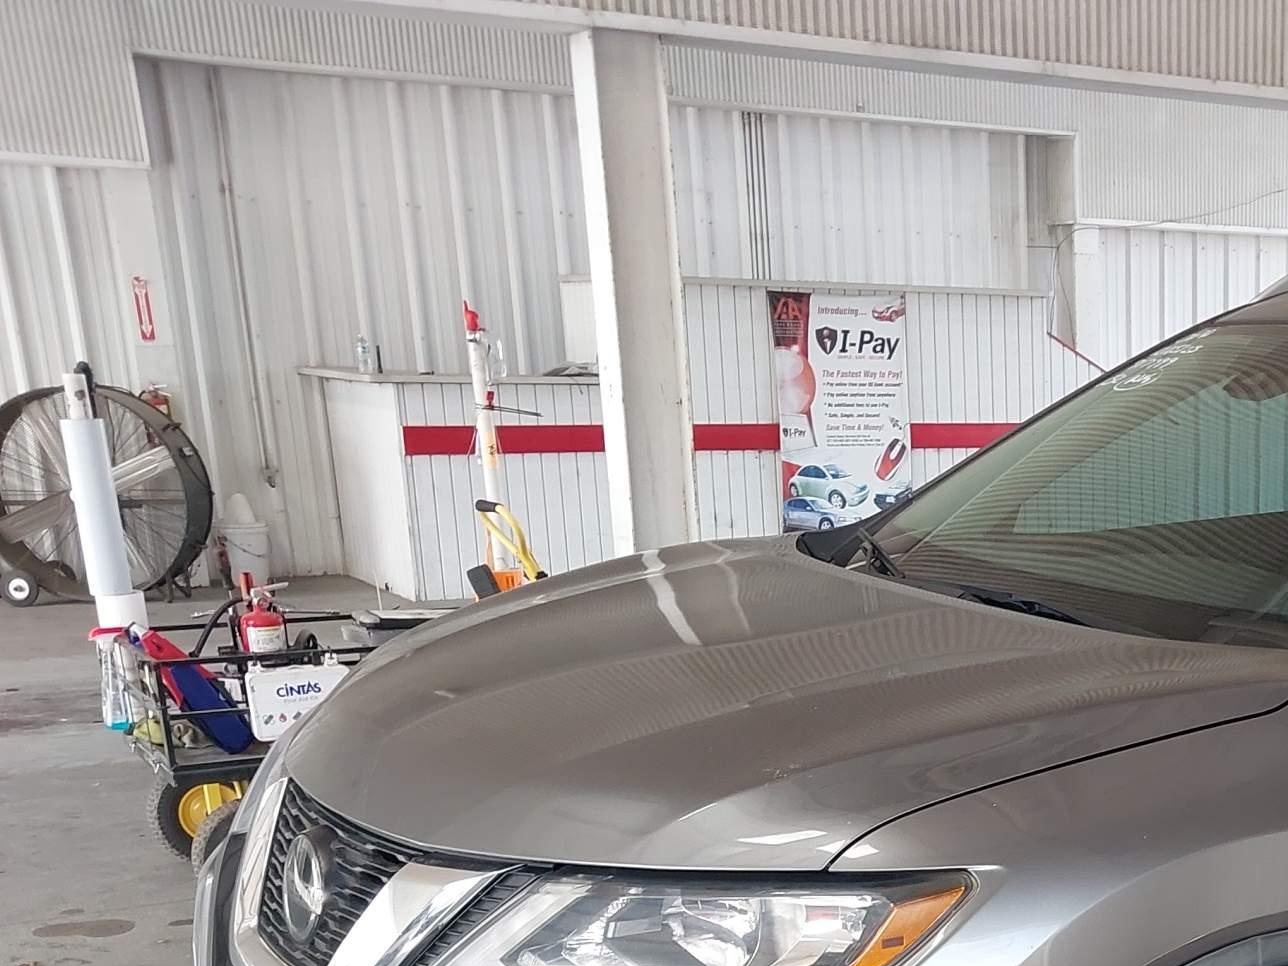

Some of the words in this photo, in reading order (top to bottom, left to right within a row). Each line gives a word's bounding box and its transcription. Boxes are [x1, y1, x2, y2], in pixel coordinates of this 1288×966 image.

[839, 329, 900, 360] I-Pay
[822, 370, 834, 378] The
[836, 370, 862, 378] Fastest
[863, 370, 878, 379] Way
[879, 370, 887, 378] to
[887, 370, 903, 380] Pay!
